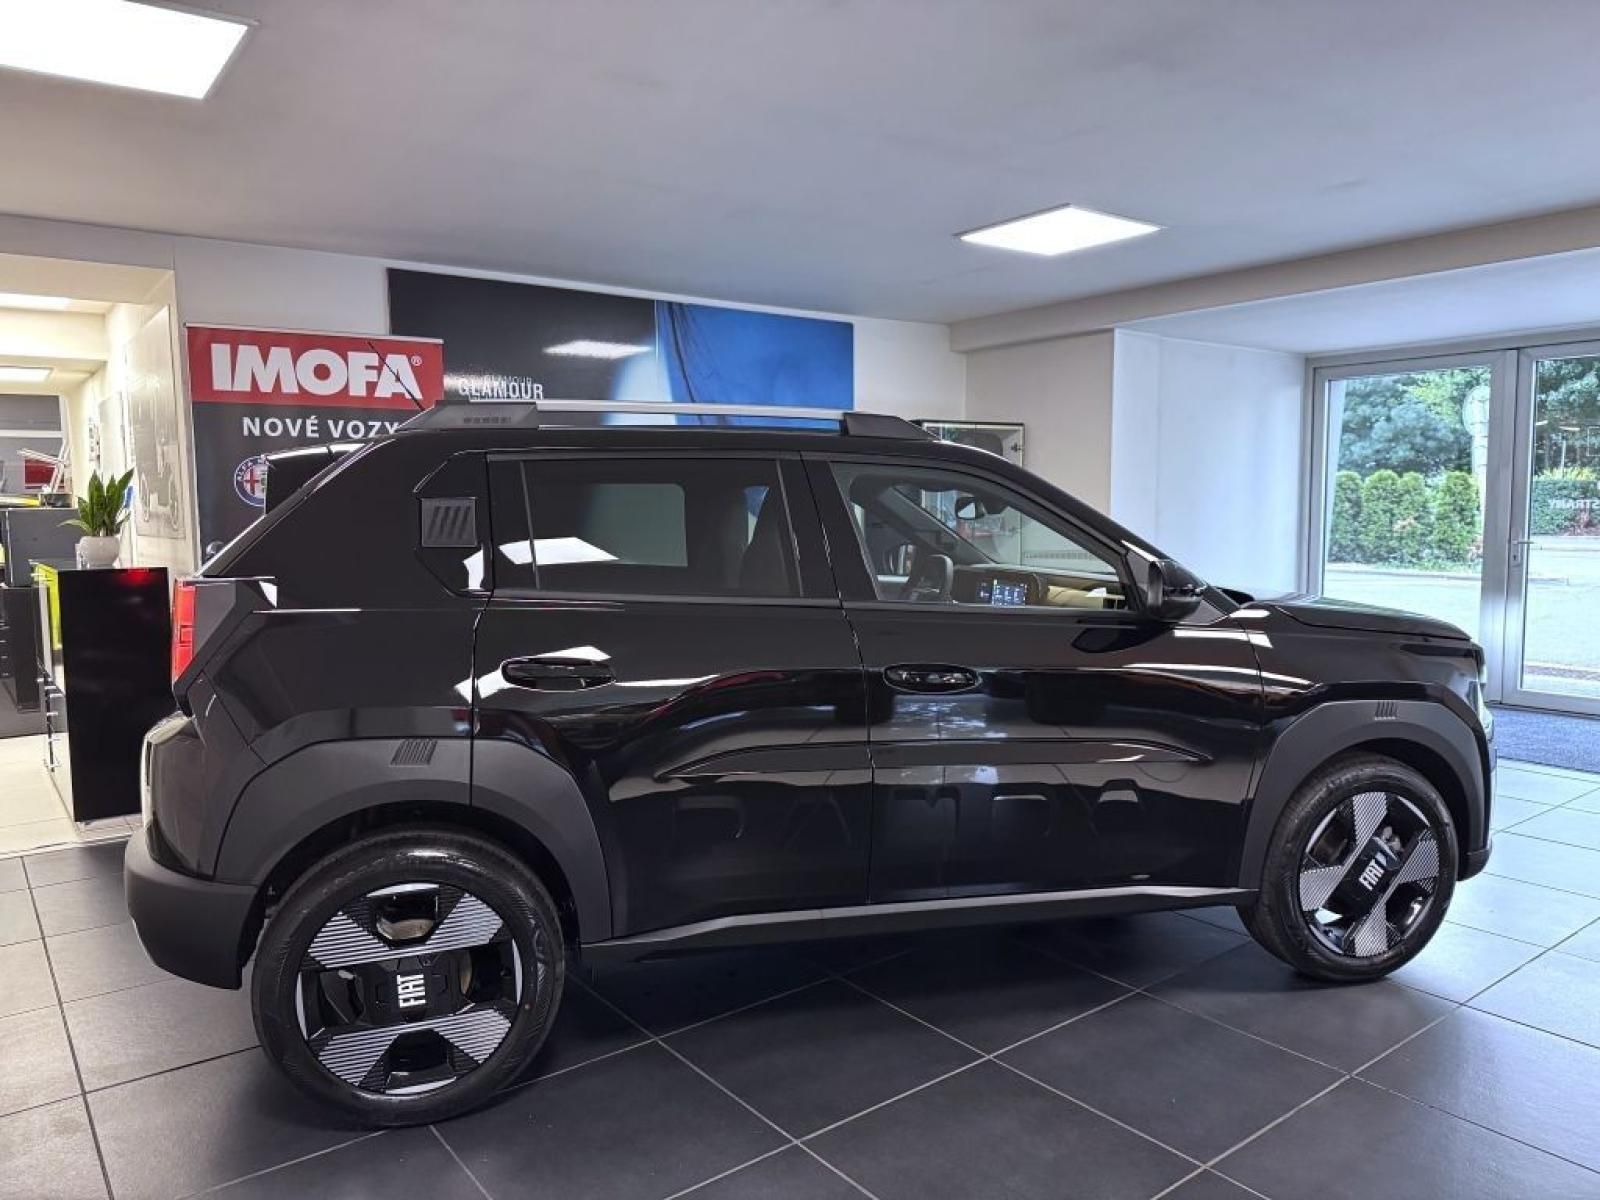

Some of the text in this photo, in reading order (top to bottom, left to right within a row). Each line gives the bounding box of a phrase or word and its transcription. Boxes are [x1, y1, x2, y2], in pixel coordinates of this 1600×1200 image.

[459, 378, 543, 400] GLAMOUR
[242, 416, 399, 439] NOVÉ VOZY
[1359, 858, 1385, 891] FIAT
[397, 973, 426, 1008] FIAT
